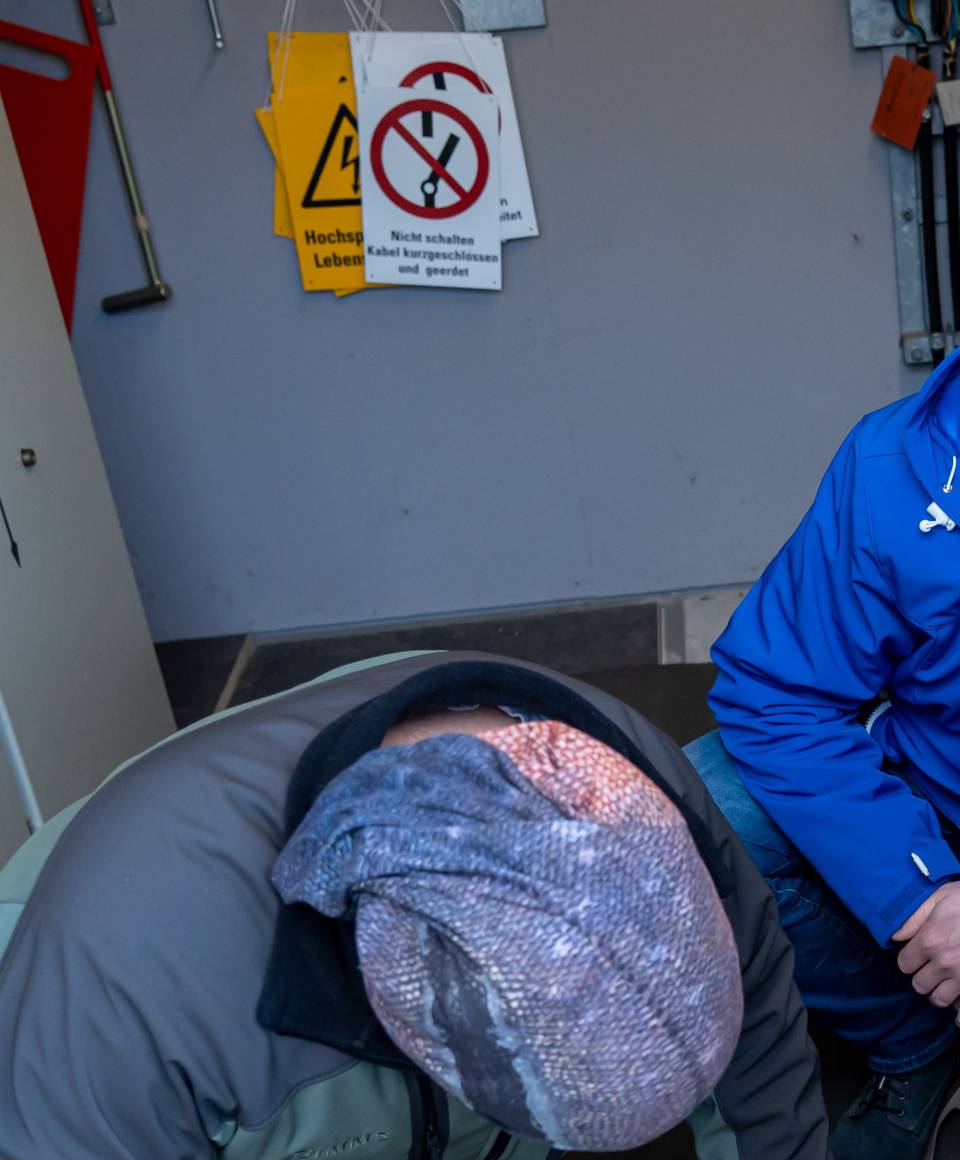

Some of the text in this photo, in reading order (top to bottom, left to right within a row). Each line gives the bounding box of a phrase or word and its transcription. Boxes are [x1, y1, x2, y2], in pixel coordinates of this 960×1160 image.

[304, 228, 364, 246] Hochsp
[391, 231, 474, 246] Nicht schalten
[367, 246, 499, 263] Kabel kurzgeschlossen
[398, 264, 469, 278] und geerdet
